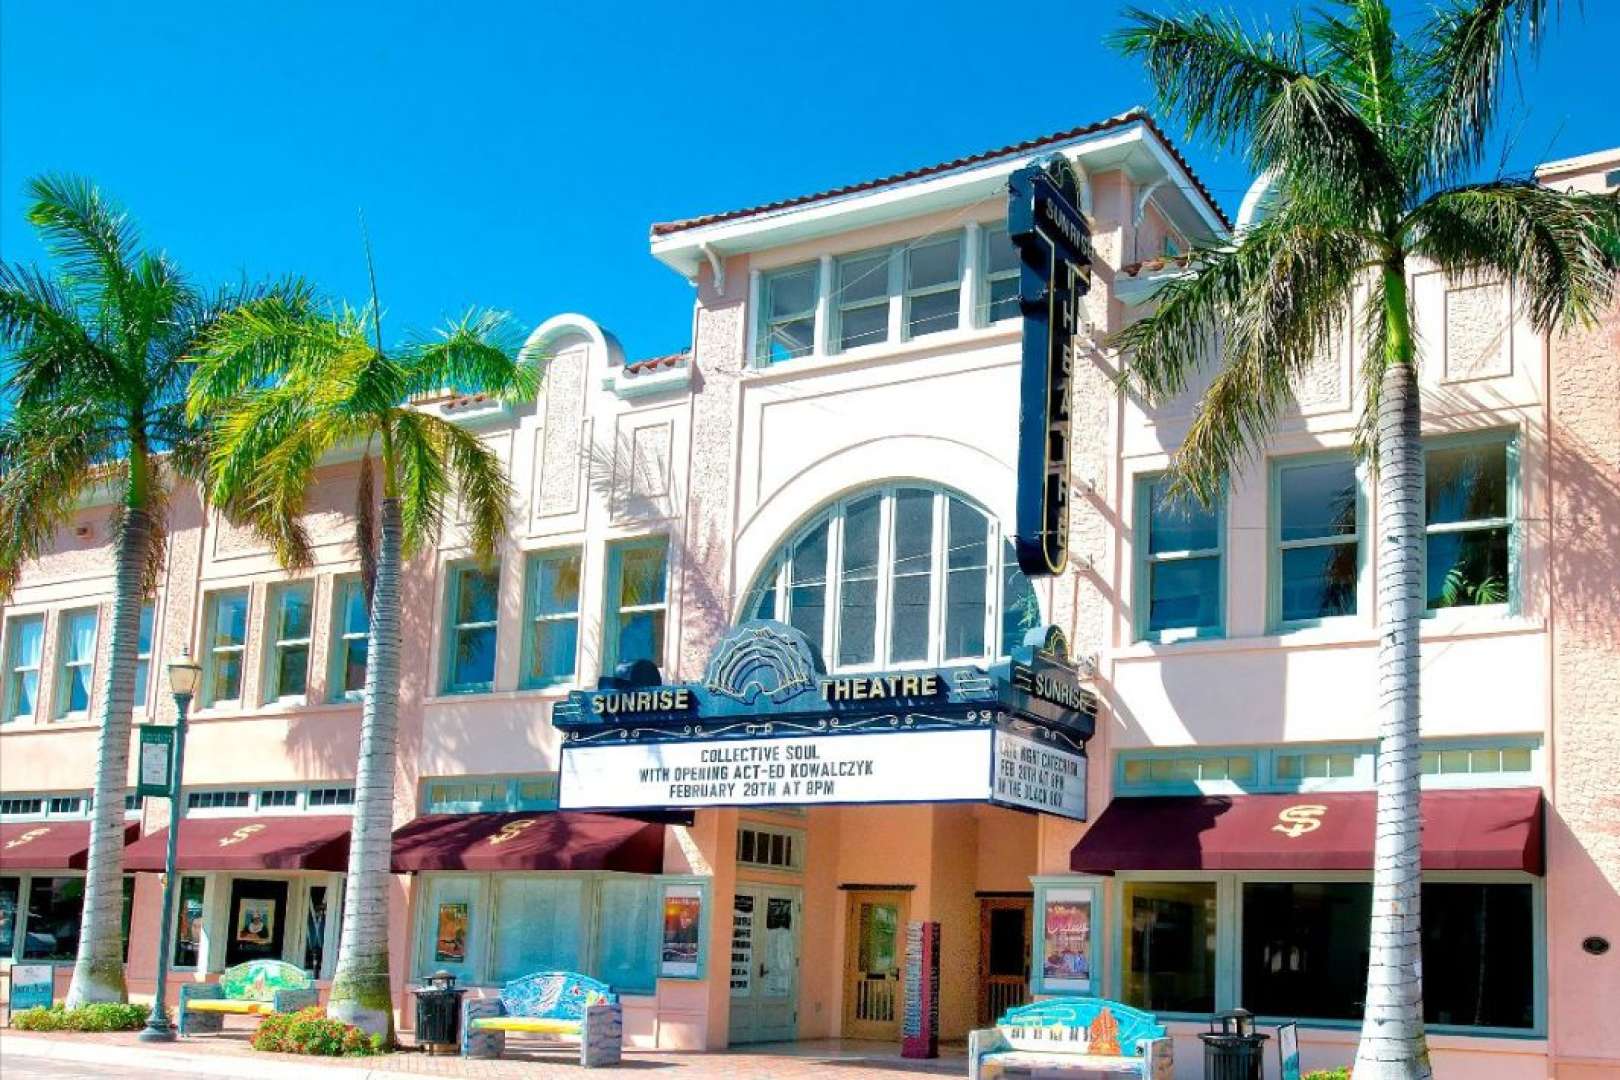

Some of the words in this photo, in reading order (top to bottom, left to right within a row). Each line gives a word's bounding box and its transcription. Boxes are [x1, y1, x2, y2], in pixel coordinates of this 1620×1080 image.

[592, 689, 689, 713] SUNRISE
[820, 676, 938, 701] THEATRE
[1036, 673, 1087, 711] SUNRISE
[701, 746, 780, 763] COLLECTIVE
[786, 744, 820, 760] SOUL
[639, 767, 669, 783] WITH
[674, 765, 728, 781] OPENING
[790, 760, 874, 778] KOWALCZYK
[669, 782, 735, 798] FEBRUARY
[783, 780, 800, 796] AT
[806, 779, 834, 796] 8PM
[1009, 780, 1021, 798] THE
